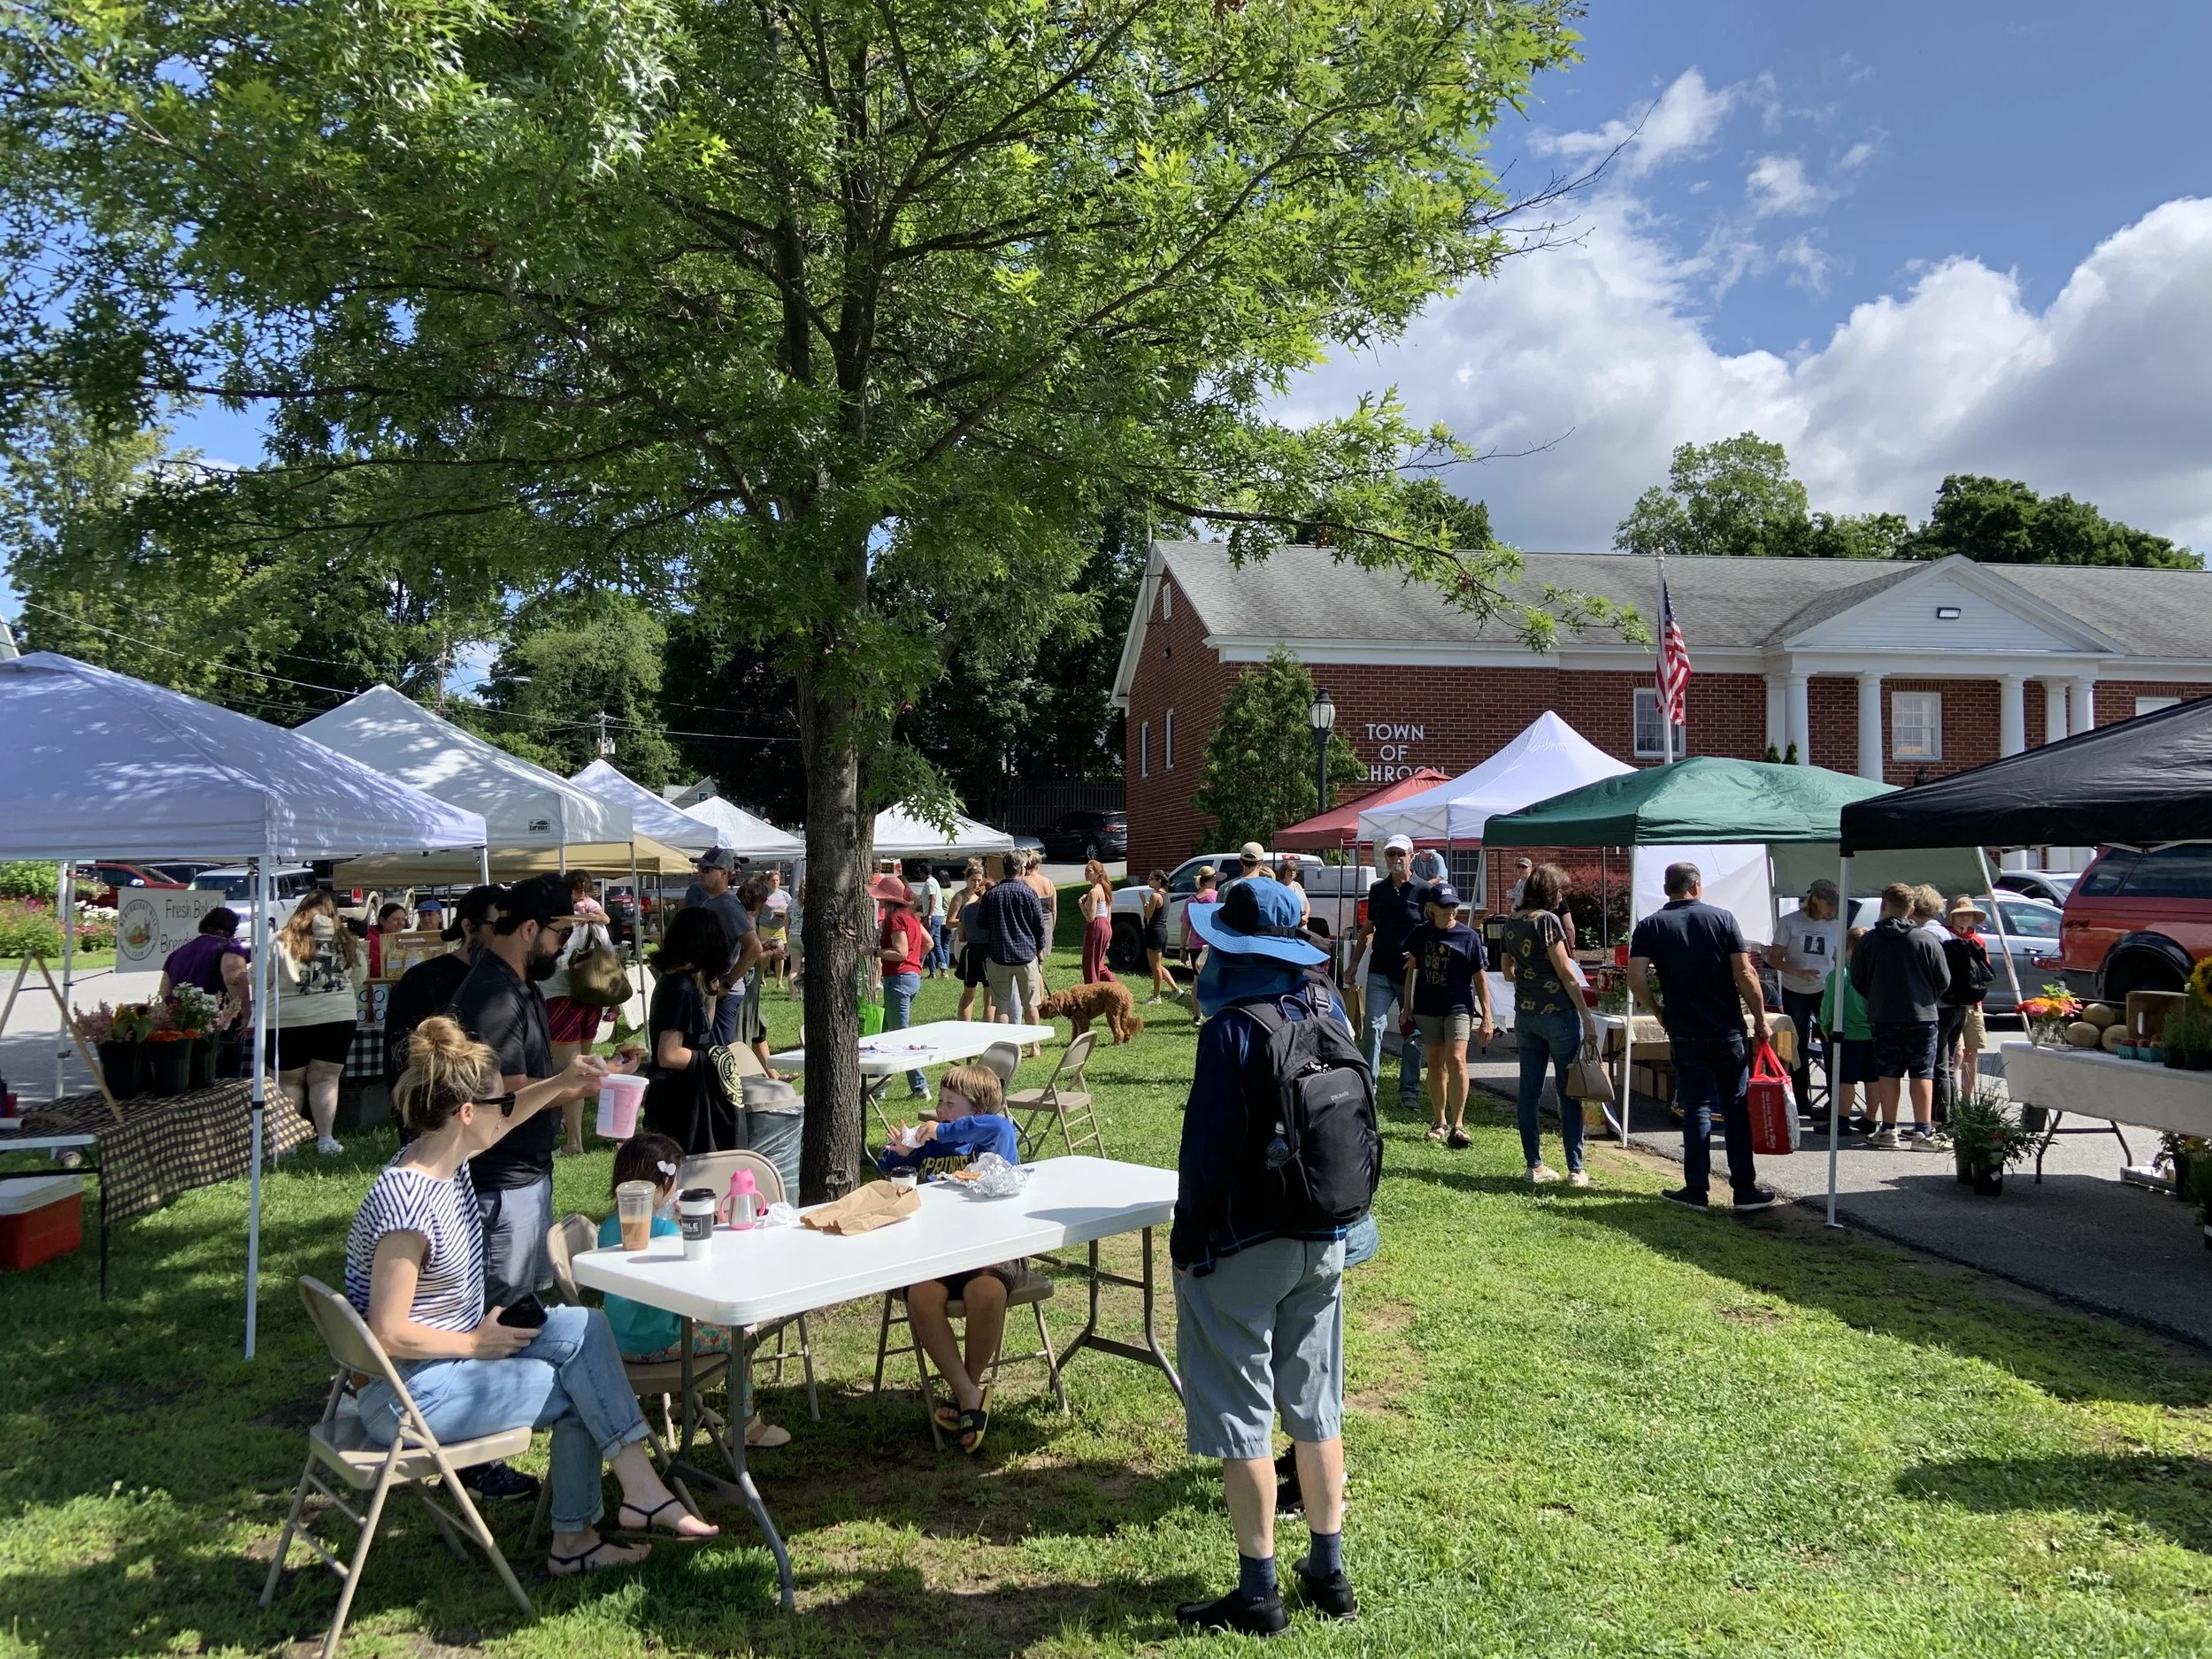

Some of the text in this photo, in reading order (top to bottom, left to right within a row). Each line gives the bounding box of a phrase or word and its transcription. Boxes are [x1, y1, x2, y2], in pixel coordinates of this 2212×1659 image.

[1364, 723, 1424, 741] TOWN
[1379, 744, 1409, 762] OF
[165, 898, 220, 919] Fresh Bak
[160, 931, 192, 954] Bread
